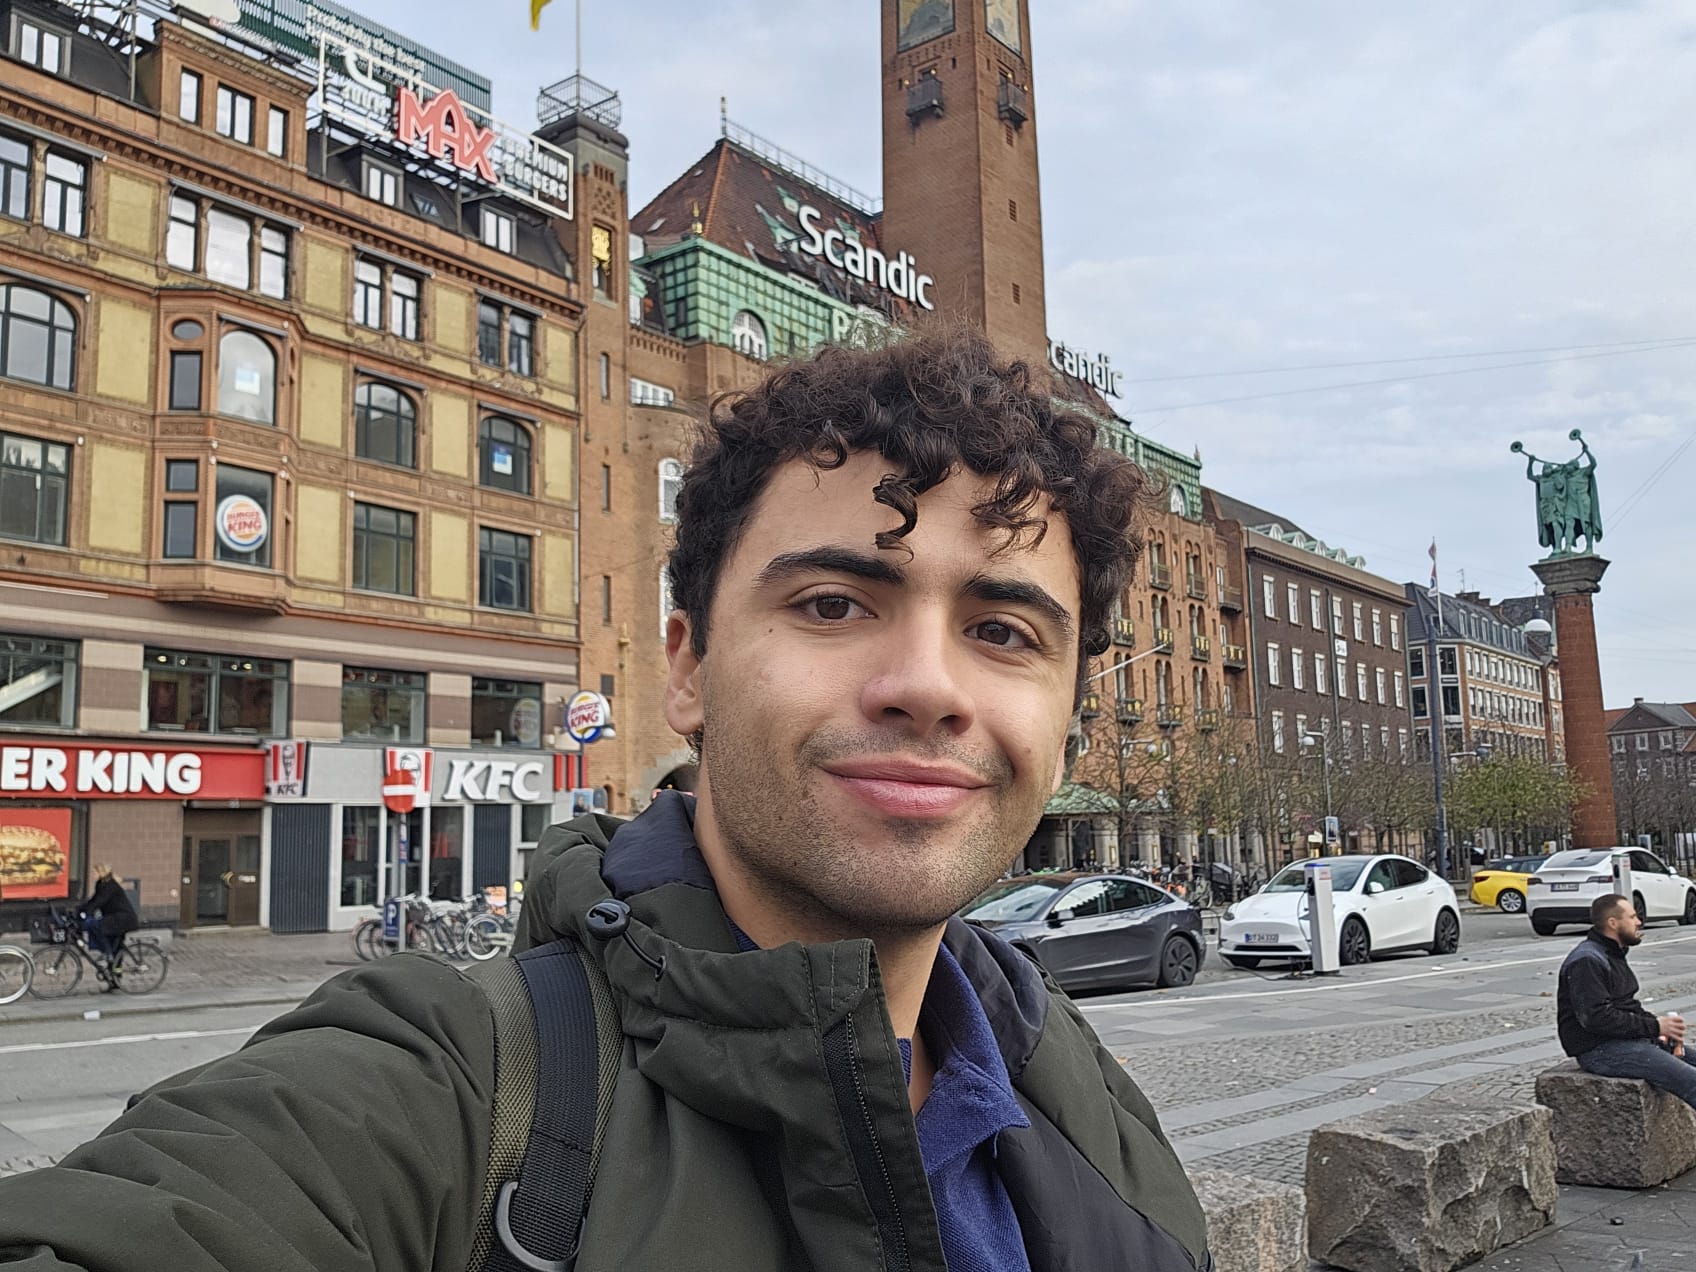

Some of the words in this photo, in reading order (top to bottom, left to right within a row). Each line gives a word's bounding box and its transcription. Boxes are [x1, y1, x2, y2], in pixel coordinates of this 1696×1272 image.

[397, 86, 499, 185] MAX
[504, 157, 568, 202] BURGERS
[799, 204, 934, 311] Scandic
[1047, 340, 1123, 399] candic
[228, 520, 262, 533] KING
[570, 711, 599, 728] KING
[76, 749, 202, 794] KING
[276, 783, 299, 796] KFC
[442, 760, 544, 801] KFC
[386, 903, 397, 925] P
